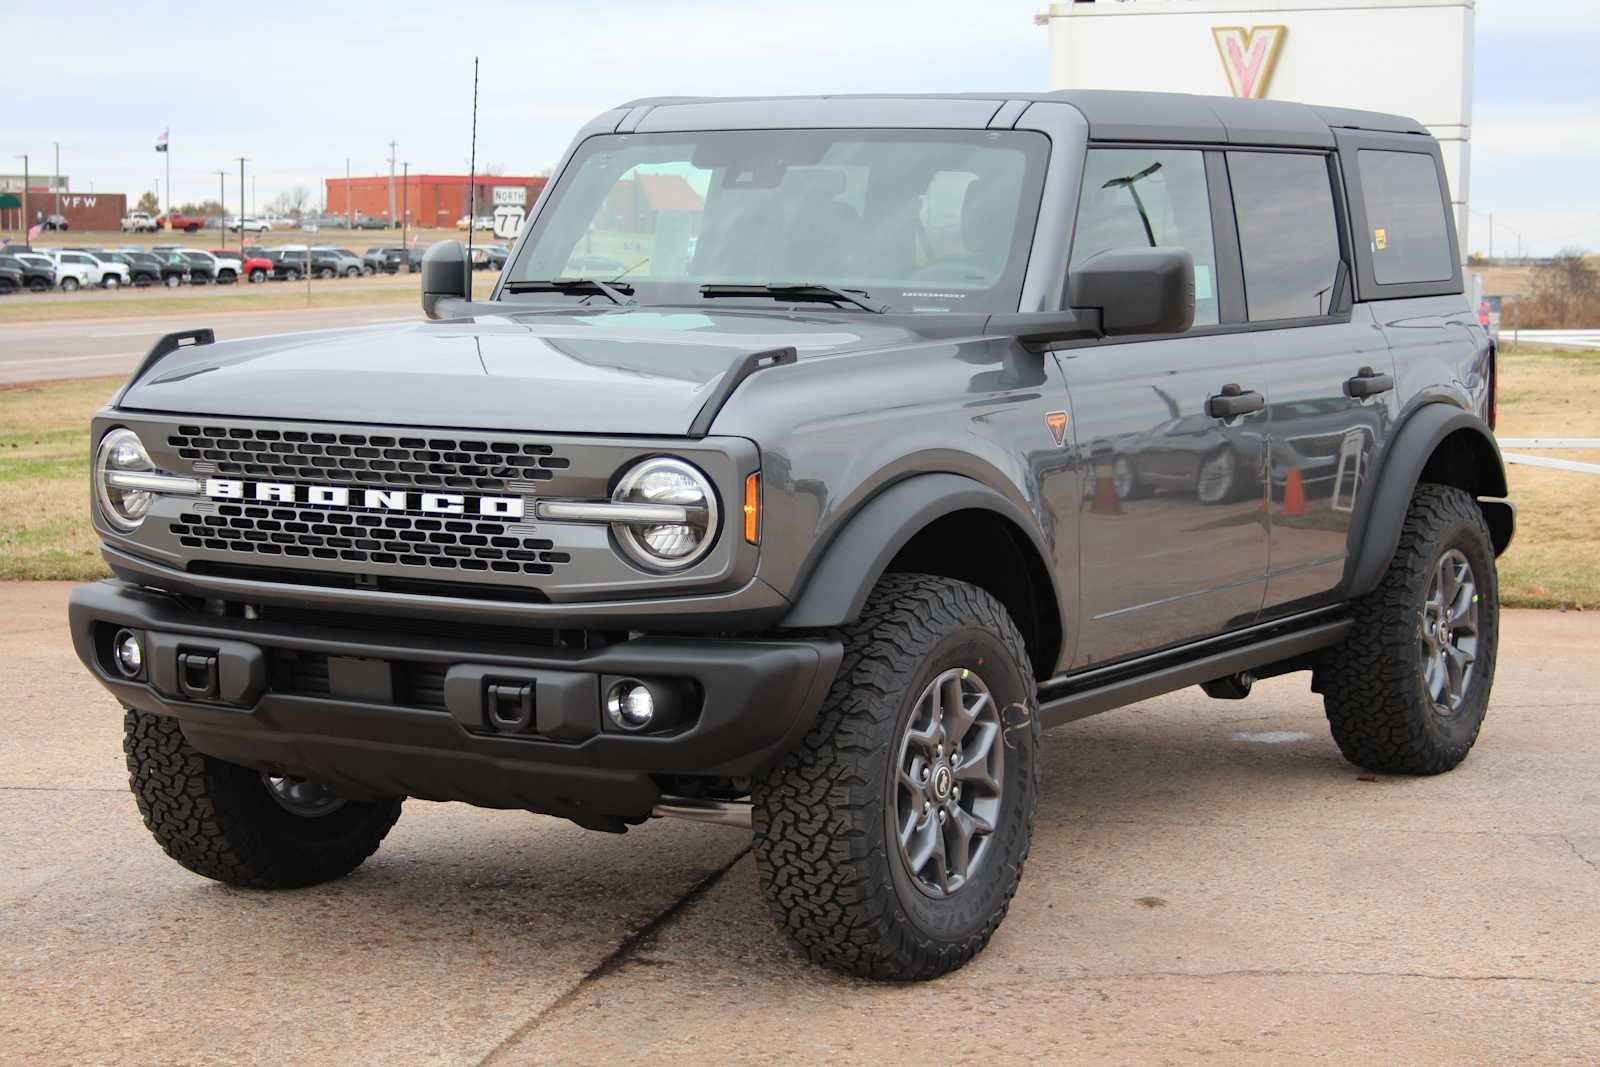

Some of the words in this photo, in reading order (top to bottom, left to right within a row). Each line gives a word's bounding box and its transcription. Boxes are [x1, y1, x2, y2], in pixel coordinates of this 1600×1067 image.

[61, 196, 97, 208] VFW
[495, 191, 525, 201] NORTH
[497, 214, 522, 232] 77
[204, 478, 525, 518] BRONCO
